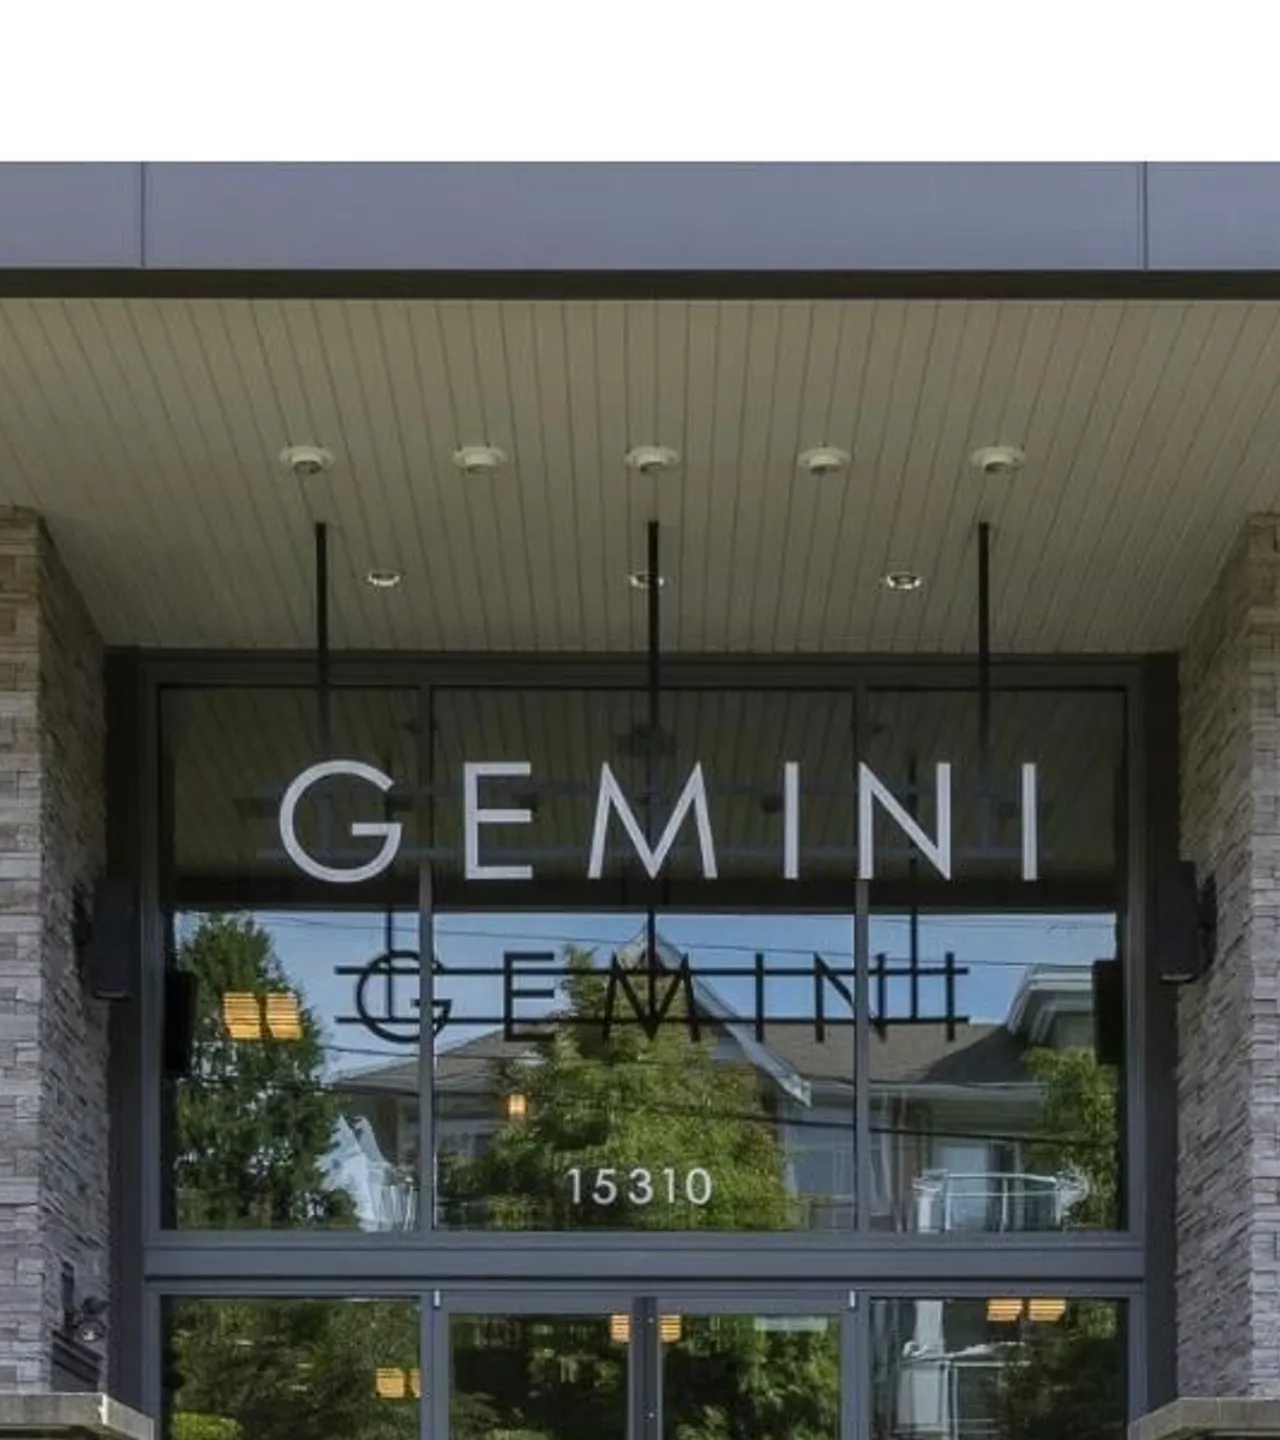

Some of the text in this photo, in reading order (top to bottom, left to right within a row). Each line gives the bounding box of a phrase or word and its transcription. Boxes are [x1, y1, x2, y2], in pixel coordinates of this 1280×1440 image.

[278, 759, 1036, 883] GEMINI
[356, 949, 957, 1041] GEMINI
[567, 1167, 712, 1205] 15310
